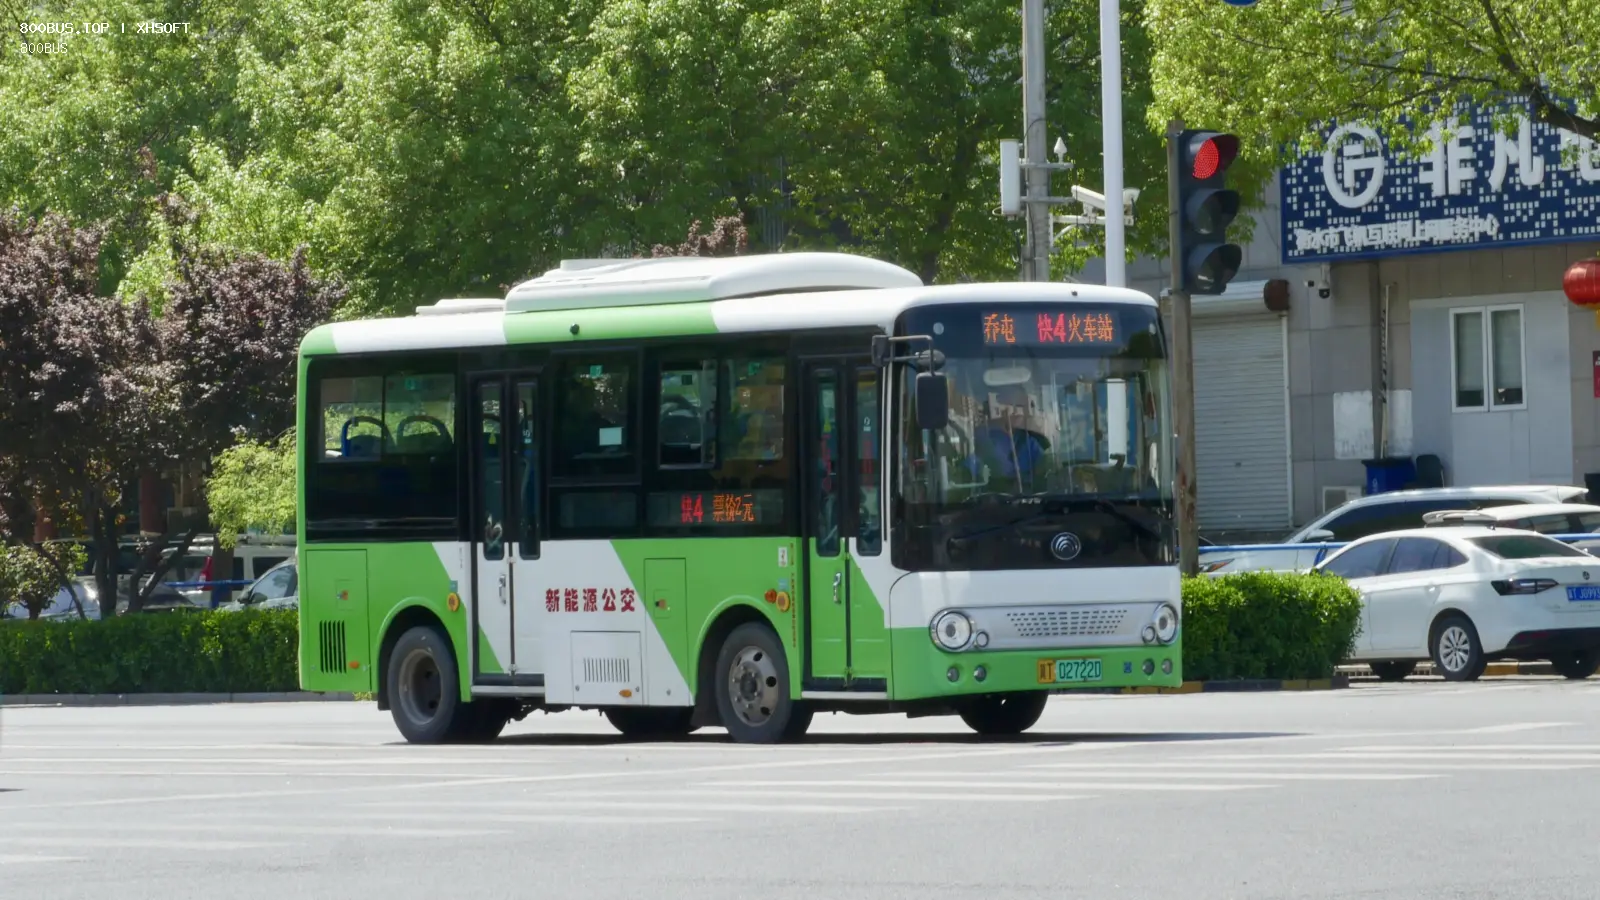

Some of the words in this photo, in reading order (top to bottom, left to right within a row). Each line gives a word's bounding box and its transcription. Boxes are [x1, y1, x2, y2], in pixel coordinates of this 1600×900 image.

[984, 313, 1016, 343] 乔屯
[681, 494, 704, 524] 快4
[713, 493, 755, 522] 票价2元
[545, 588, 635, 612] 新能源公交
